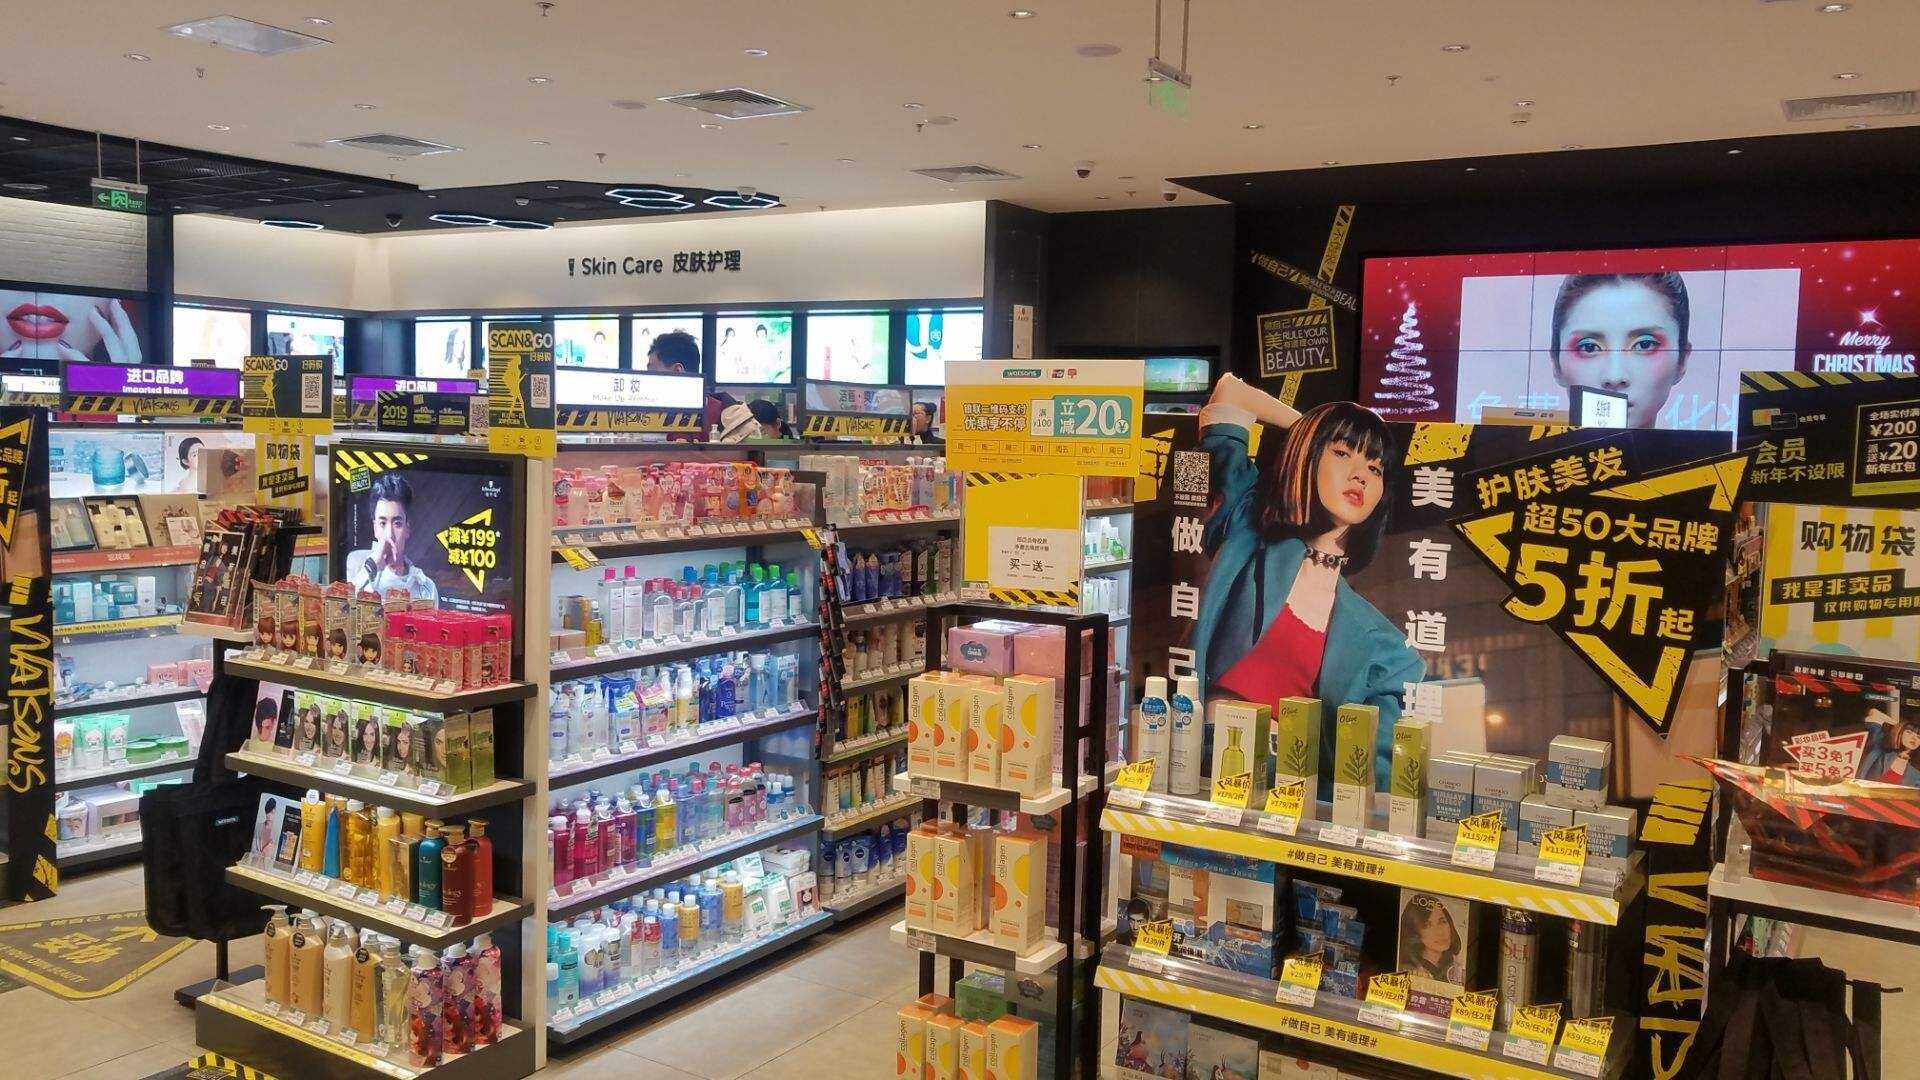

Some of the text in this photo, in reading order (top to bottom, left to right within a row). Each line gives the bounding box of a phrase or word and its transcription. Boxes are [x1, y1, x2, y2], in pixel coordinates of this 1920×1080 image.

[581, 250, 741, 275] Skin Care 皮肤护理
[1839, 331, 1891, 353] Merry
[1812, 353, 1916, 373] CHRISTMAS
[126, 368, 185, 385] 进口品牌
[122, 386, 189, 395] Imported Brand
[382, 405, 408, 419] 2019
[1076, 399, 1122, 436] 20
[964, 416, 1027, 432] 优惠享不停
[1870, 420, 1917, 437] ¥200
[1754, 438, 1807, 465] 会员
[1880, 440, 1918, 461] ¥20
[1476, 447, 1628, 509] 护肤美发
[1750, 461, 1846, 486] 新年不设限
[1865, 461, 1917, 476] 新年红包
[1522, 501, 1721, 556] 超50大品牌
[1801, 520, 1917, 557] 购物袋
[448, 549, 497, 569] 减¥100
[1008, 557, 1054, 573] 买一送一
[1782, 575, 1893, 600] 我是非卖品
[911, 685, 920, 718] collagen
[936, 688, 945, 722] collagen
[1007, 686, 1015, 720] collagen
[1801, 745, 1854, 764] 买3免1
[1800, 761, 1855, 779] 买5免2
[1469, 816, 1502, 832] 风暴价
[1553, 829, 1587, 846] 风暴价
[1000, 844, 1008, 879] collagen
[1287, 848, 1385, 876] #做自己 美有道理#
[1280, 1015, 1378, 1048] #做自己 美有道理#
